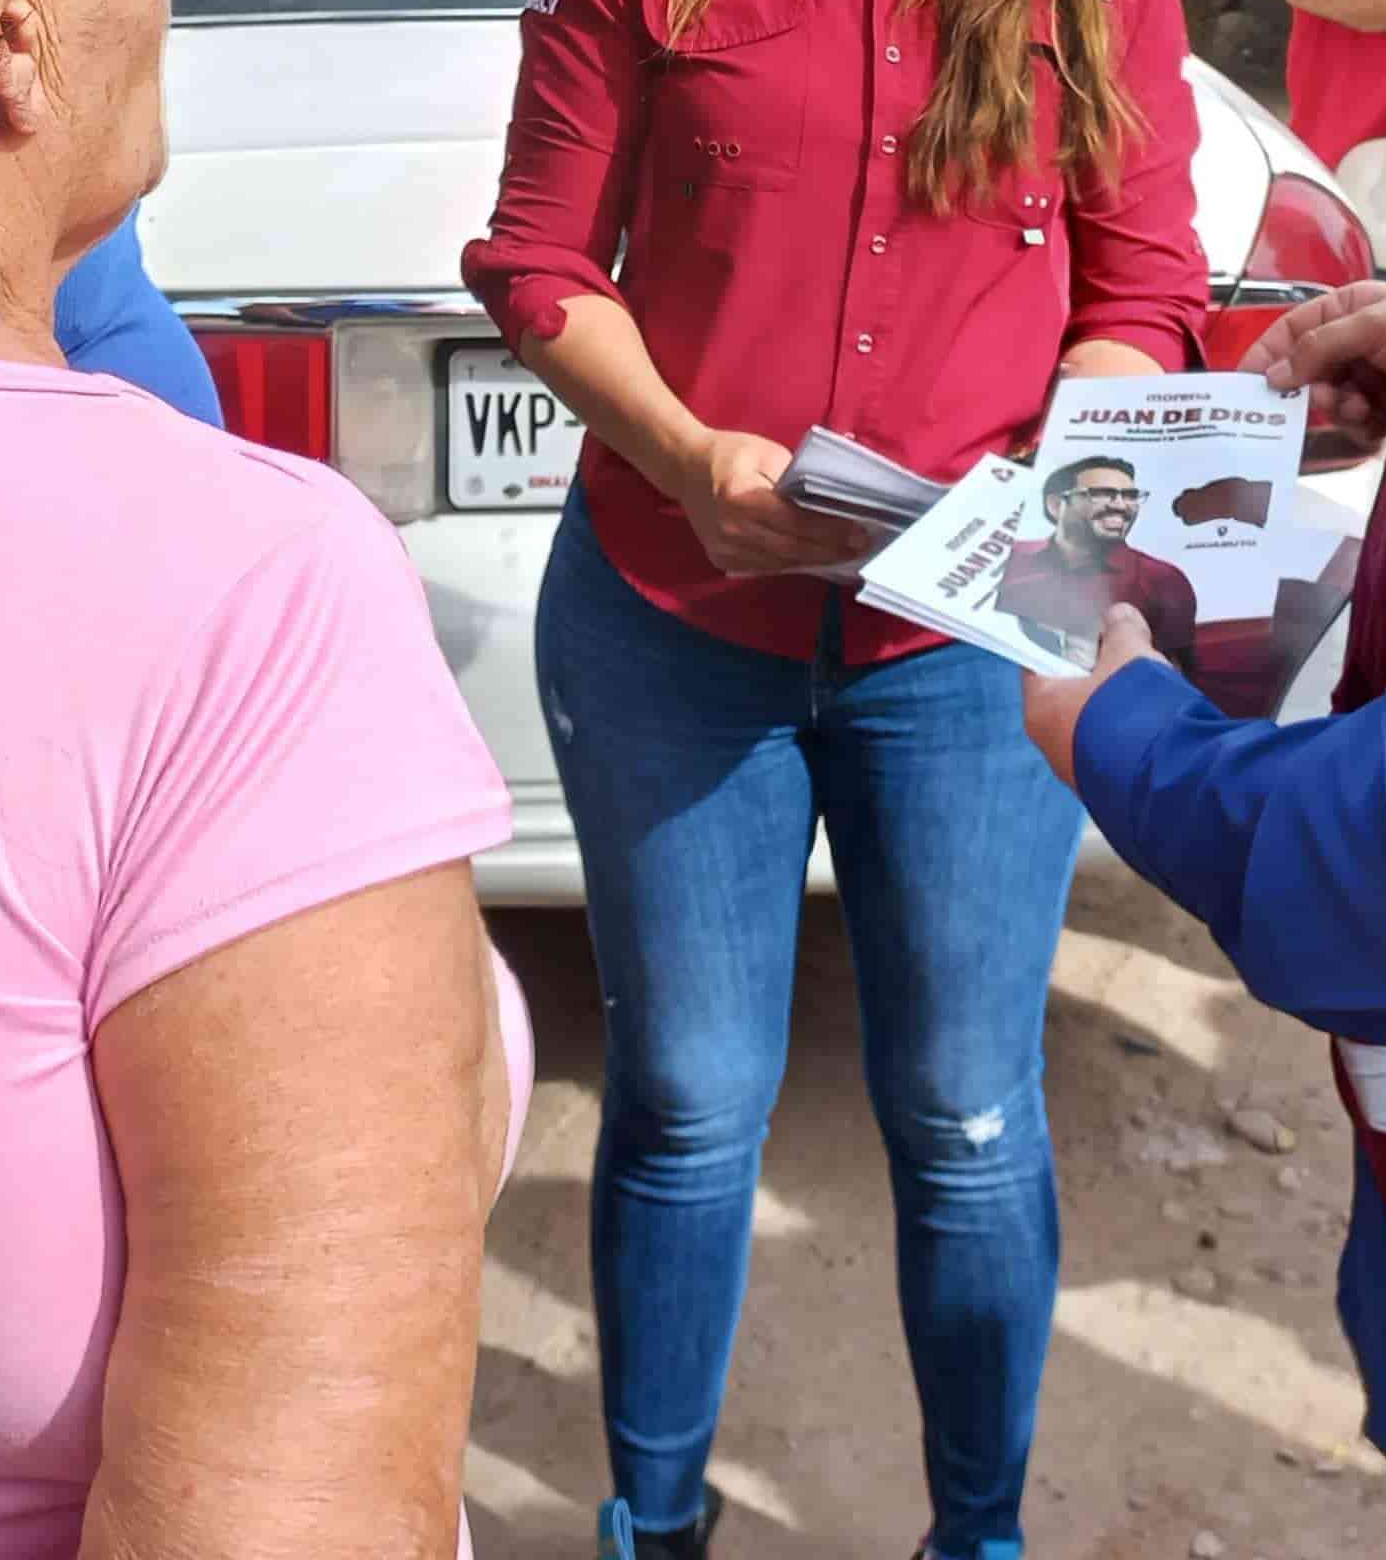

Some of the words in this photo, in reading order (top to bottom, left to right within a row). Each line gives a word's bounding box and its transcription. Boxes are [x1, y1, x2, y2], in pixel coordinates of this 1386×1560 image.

[1069, 409, 1155, 425] JUAN
[1162, 407, 1201, 425] DE
[1209, 407, 1286, 426] DIOS
[936, 551, 993, 598] JUAN
